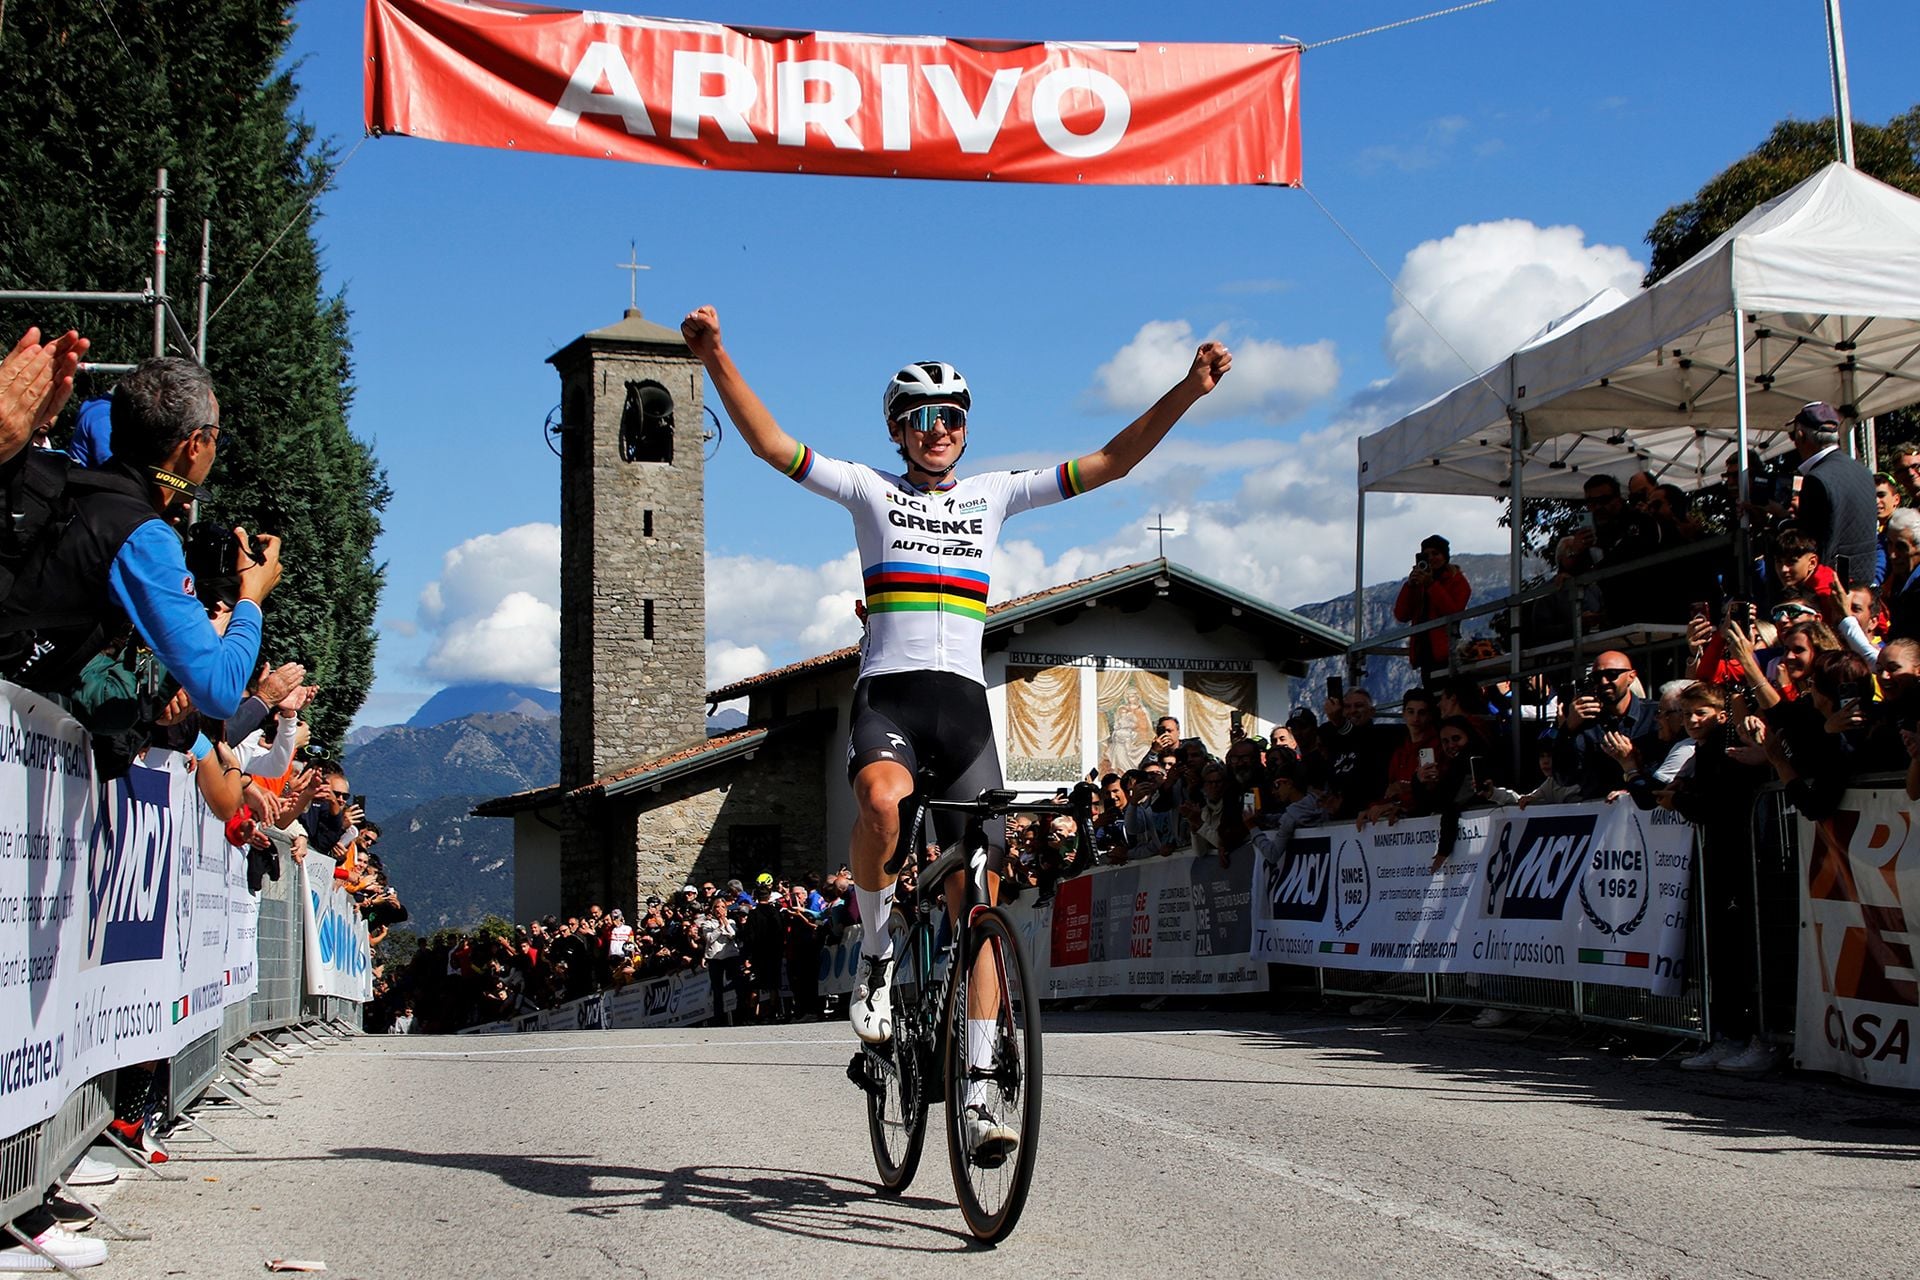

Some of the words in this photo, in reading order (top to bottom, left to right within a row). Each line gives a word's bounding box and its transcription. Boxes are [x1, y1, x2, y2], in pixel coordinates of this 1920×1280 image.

[548, 42, 1131, 158] ARRIVO
[155, 472, 188, 489] Nikon
[893, 494, 927, 513] UCI
[958, 498, 987, 509] BORA
[888, 510, 983, 535] GRENKE
[107, 797, 170, 922] MCV
[1505, 834, 1591, 900] MCV
[1592, 850, 1642, 871] SINCE
[1273, 852, 1331, 906] MCV
[1341, 867, 1364, 884] SINCE
[1344, 889, 1363, 905] 1962
[1598, 878, 1638, 898] 1962
[1135, 892, 1148, 911] GE
[1130, 938, 1152, 958] NALE
[1513, 935, 1564, 968] passion
[114, 988, 162, 1055] passion
